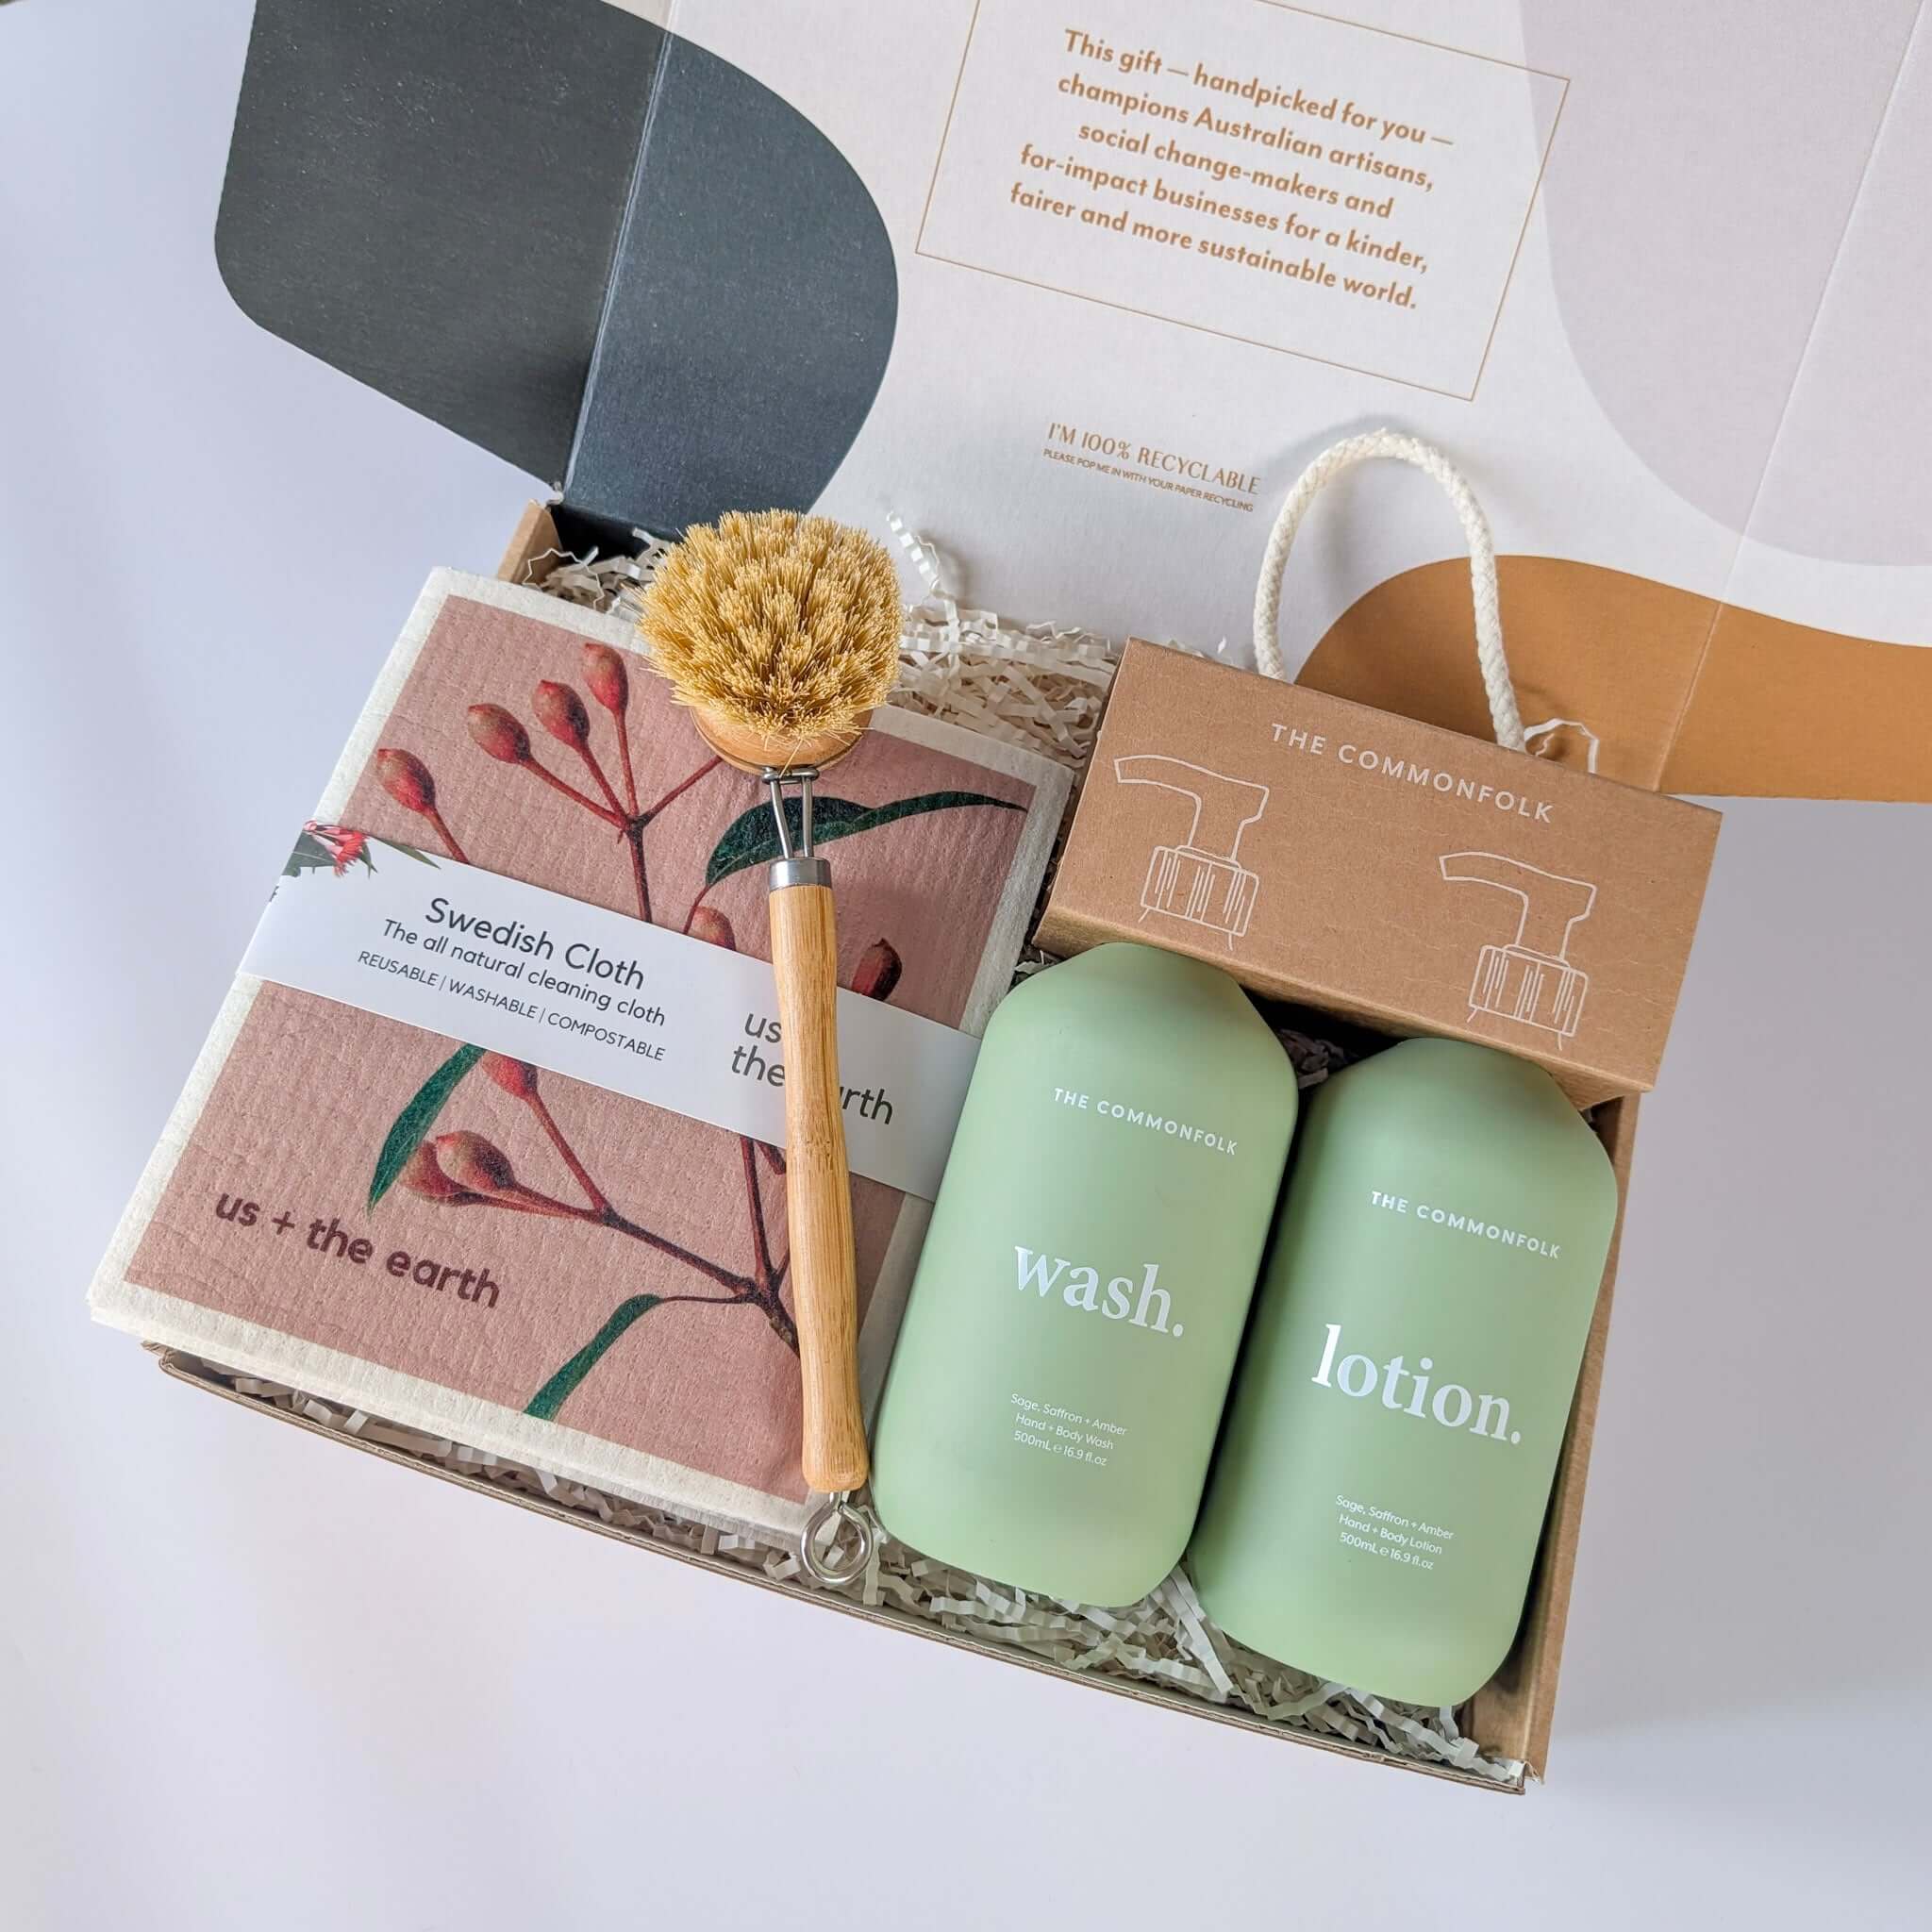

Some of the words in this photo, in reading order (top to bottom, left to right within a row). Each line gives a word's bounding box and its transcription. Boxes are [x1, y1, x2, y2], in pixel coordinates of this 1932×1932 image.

[1065, 29, 1113, 61] This
[1119, 50, 1161, 74] gift
[1194, 63, 1338, 120] handpicked
[1341, 102, 1377, 129] for
[1381, 121, 1425, 143] you
[1058, 74, 1189, 123] champions
[1194, 108, 1322, 158] Australian
[1329, 150, 1432, 192] artisans,
[1079, 126, 1150, 154] social
[1155, 140, 1339, 204] change-makers
[1345, 196, 1393, 218] and
[1011, 182, 1075, 217] fairer
[1081, 209, 1128, 231] and
[1132, 223, 1191, 249] more
[1198, 241, 1336, 287] sustainable
[1343, 278, 1415, 308] world.
[1022, 143, 1147, 195] for-impact
[1153, 178, 1278, 230] businesses
[1286, 213, 1320, 240] for
[1325, 232, 1340, 246] a
[1346, 229, 1426, 274] kinder,
[1043, 449, 1074, 464] PLEASE
[1076, 458, 1095, 468] POP
[1096, 463, 1110, 474] ME
[1122, 471, 1146, 482] WITH
[1148, 477, 1174, 491] YOUR
[1174, 485, 1202, 498] PAPER
[1203, 492, 1253, 511] RECYCLING
[1049, 423, 1075, 444] I'M
[1082, 432, 1130, 459] 100%
[1138, 447, 1260, 494] RECYCLABLE
[1272, 724, 1325, 755] THE
[1339, 745, 1553, 823] COMMONFOLK
[385, 920, 417, 943] The
[424, 937, 448, 954] all
[451, 947, 525, 978] natural
[528, 970, 611, 1010] cleaning
[618, 999, 664, 1025] cloth
[425, 898, 553, 959] Swedish
[565, 943, 643, 989] Cloth
[358, 951, 439, 986] REUSABLE
[450, 979, 538, 1018] WASHABLE
[548, 1013, 665, 1060] COMPOSTABLE
[744, 1013, 782, 1043] us
[732, 1045, 785, 1087] the
[840, 1087, 892, 1124] rth
[1056, 1088, 1089, 1108] THE
[1097, 1101, 1237, 1155] COMMONFOLK
[216, 1193, 260, 1226] us
[272, 1211, 295, 1235] +
[307, 1219, 373, 1264] the
[387, 1251, 499, 1307] earth
[1373, 1191, 1407, 1213] THE
[1417, 1206, 1559, 1258] COMMONFOLK
[1015, 1245, 1183, 1337] wash.
[1043, 1404, 1082, 1424] Saffron
[1091, 1419, 1126, 1434] Amber
[1311, 1324, 1520, 1443] lotion.
[1014, 1430, 1051, 1451] 500mL
[1064, 1446, 1083, 1459] 16.9
[1016, 1413, 1046, 1430] Hand
[1057, 1426, 1083, 1442] Body
[1086, 1434, 1113, 1449] Wash
[1336, 1495, 1366, 1514] Sage,
[1369, 1507, 1408, 1526] Saffron
[1418, 1523, 1454, 1539] Amber
[1340, 1513, 1371, 1532] Hand
[1380, 1527, 1408, 1546] Body
[1410, 1537, 1441, 1554] Lotion
[1341, 1532, 1377, 1555] 500mL
[1391, 1548, 1411, 1563] 16.9
